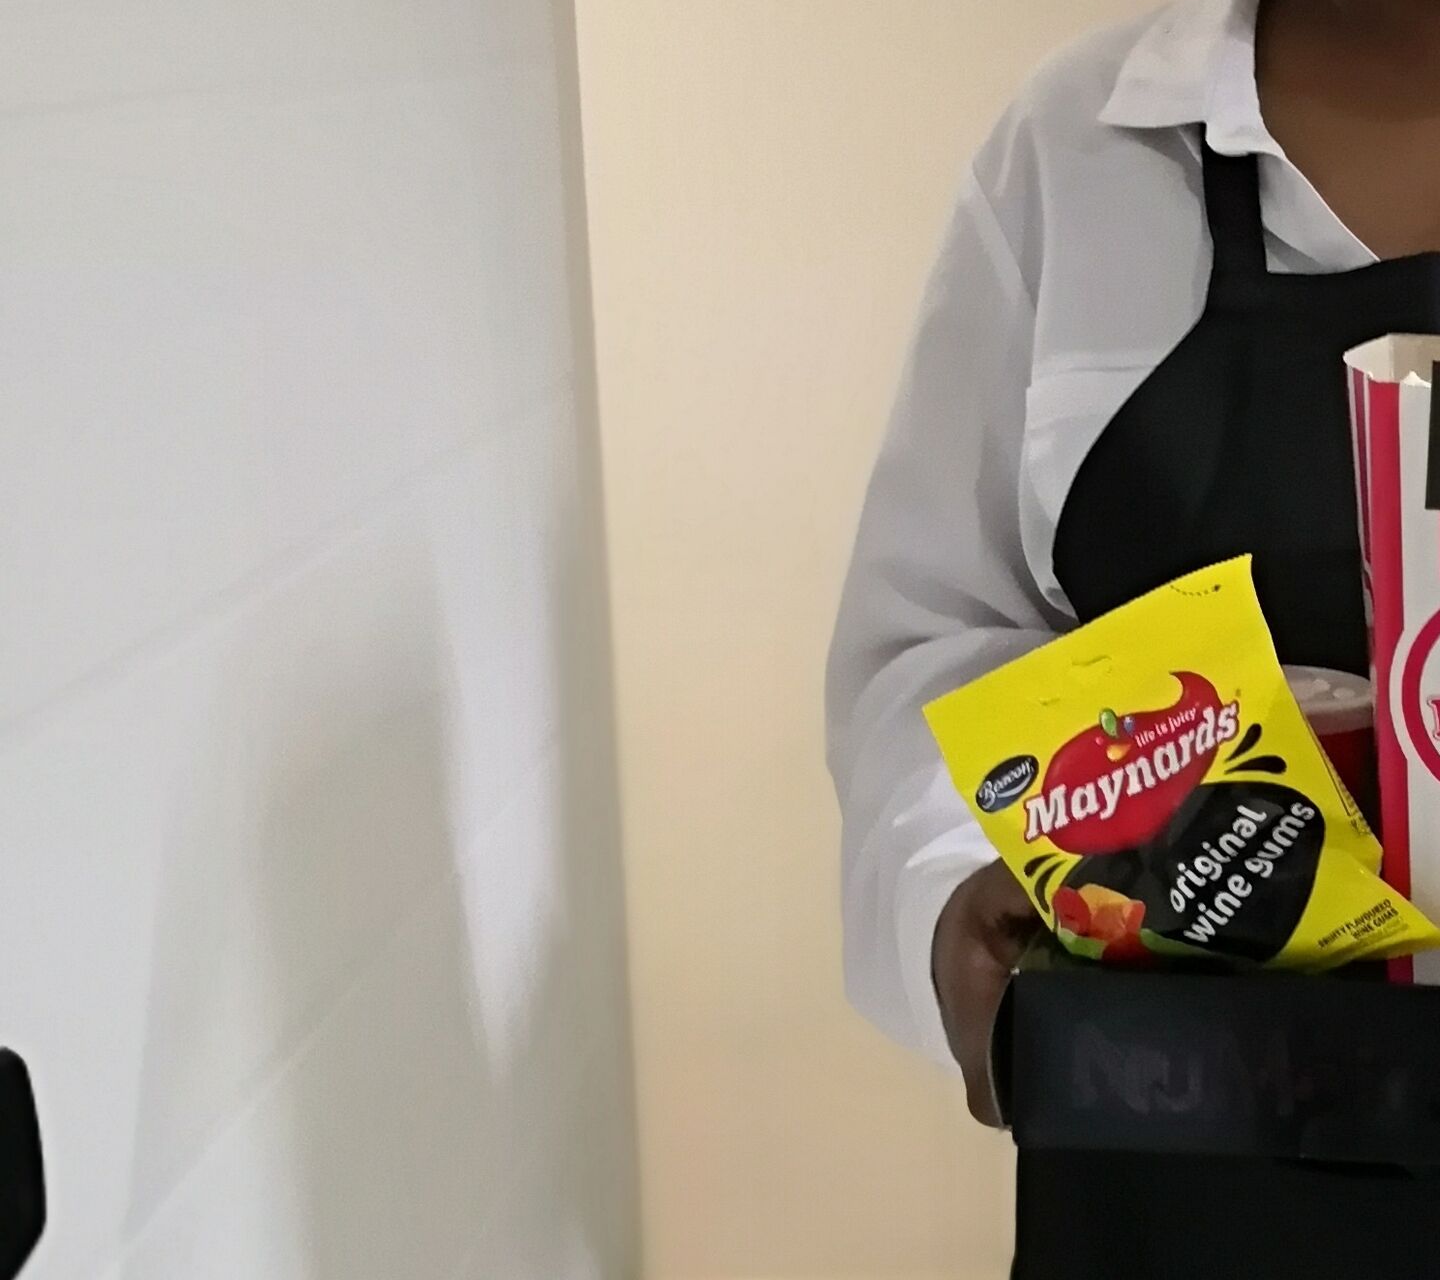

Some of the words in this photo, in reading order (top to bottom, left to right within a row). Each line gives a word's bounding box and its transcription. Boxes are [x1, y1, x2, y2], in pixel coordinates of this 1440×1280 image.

[1025, 702, 1239, 841] Maynards
[1170, 805, 1268, 914] original
[1183, 873, 1253, 943] wine
[1244, 802, 1316, 879] gums
[1373, 907, 1399, 928] GUMS
